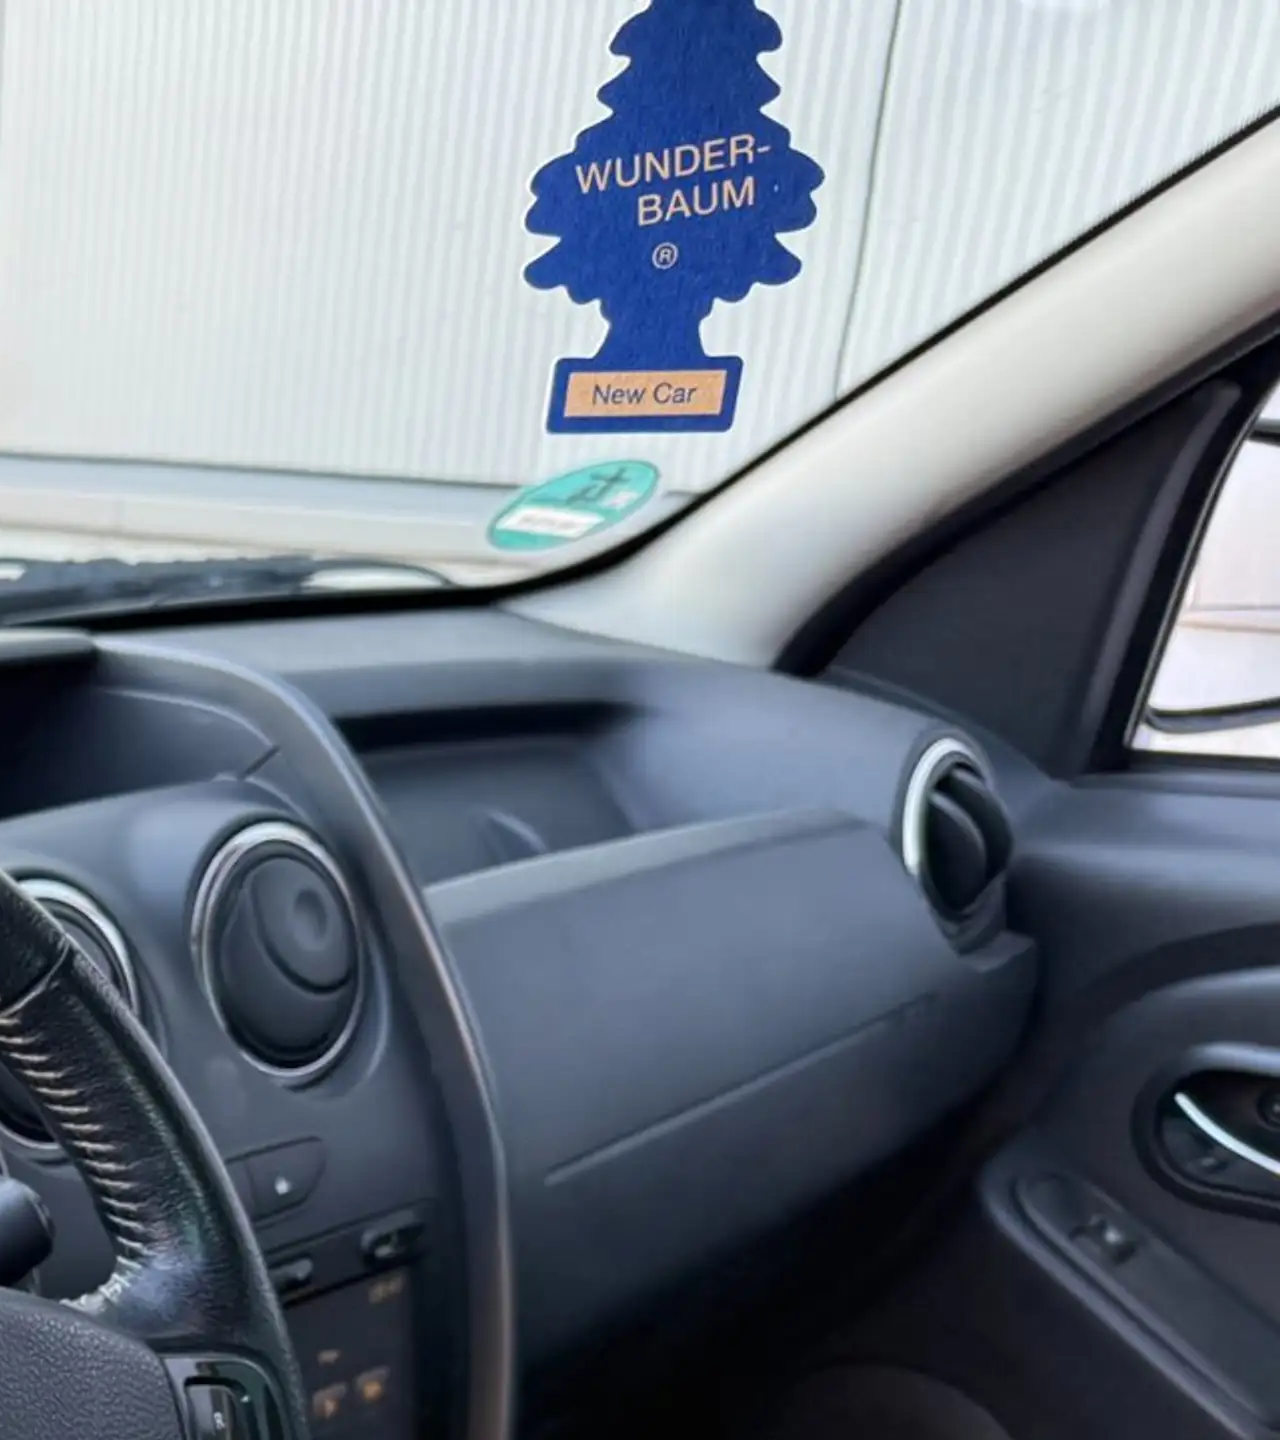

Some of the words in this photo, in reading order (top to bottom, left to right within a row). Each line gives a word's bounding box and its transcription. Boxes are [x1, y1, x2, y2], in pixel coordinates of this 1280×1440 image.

[575, 134, 771, 194] WUNDER-
[638, 176, 755, 226] BAUM
[592, 384, 646, 406] New
[653, 382, 697, 404] Car
